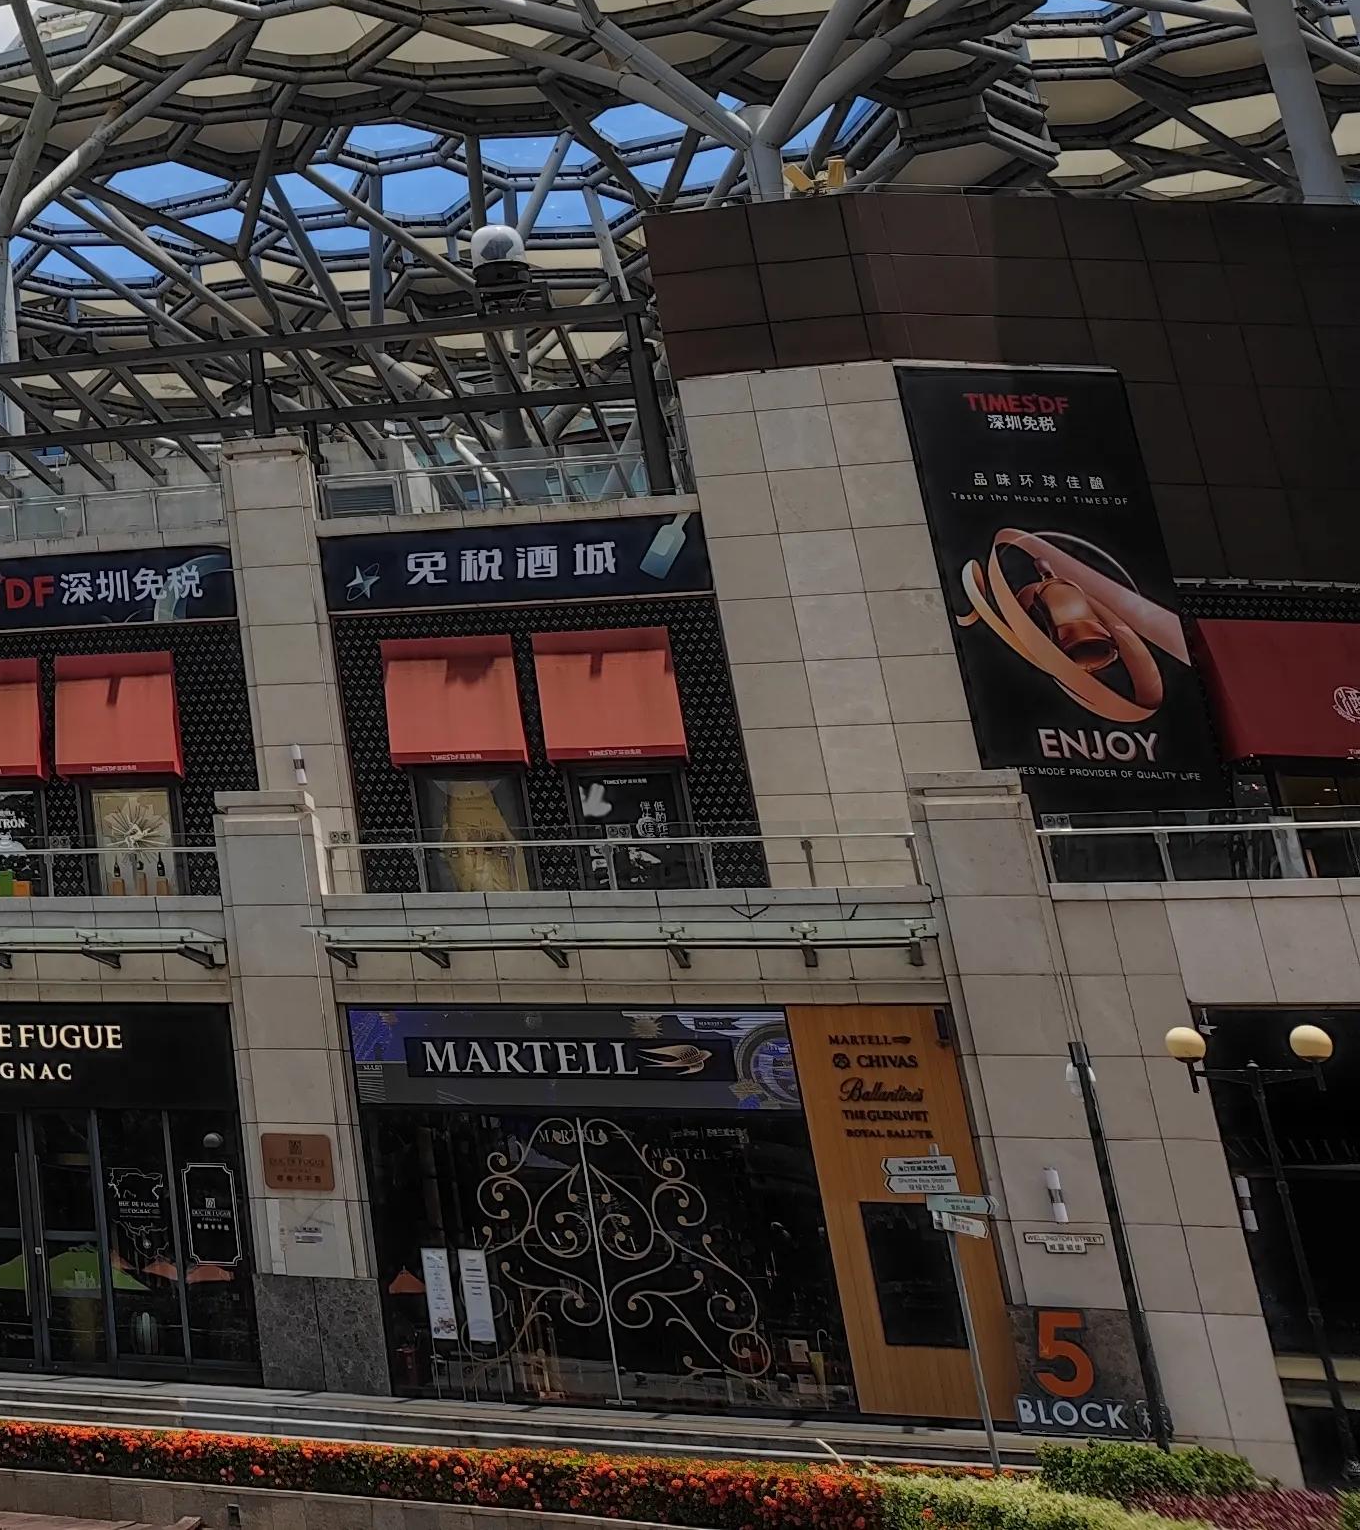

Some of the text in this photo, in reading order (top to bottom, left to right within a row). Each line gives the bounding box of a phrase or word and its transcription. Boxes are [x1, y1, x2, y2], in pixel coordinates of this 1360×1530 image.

[987, 414, 1057, 432] 深圳免税
[973, 472, 1105, 490] 品味环球佳酿
[951, 491, 984, 501] Taste
[991, 493, 1009, 502] the
[1014, 494, 1049, 503] House
[1055, 495, 1067, 503] of
[406, 541, 617, 585] 免税酒城
[59, 565, 204, 606] 深圳免税
[1037, 728, 1159, 762] ENJOY
[1069, 768, 1117, 778] PROVIDER
[1120, 770, 1133, 778] OF
[1136, 771, 1177, 780] QUALITY
[1180, 772, 1201, 781] LIFE
[17, 1025, 123, 1049] FUGUE
[828, 1035, 892, 1046] MARTELL
[422, 1041, 639, 1076] MARTELL
[856, 1054, 919, 1068] CHIVAS
[839, 1077, 924, 1102] Ballantine's
[842, 1110, 928, 1123] THE GLENLIVET
[845, 1129, 934, 1139] ROYAL SALUTE
[1026, 1234, 1104, 1245] WELLINGTON STREET
[1034, 1311, 1095, 1398] 5
[1016, 1398, 1129, 1430] BLOCK
